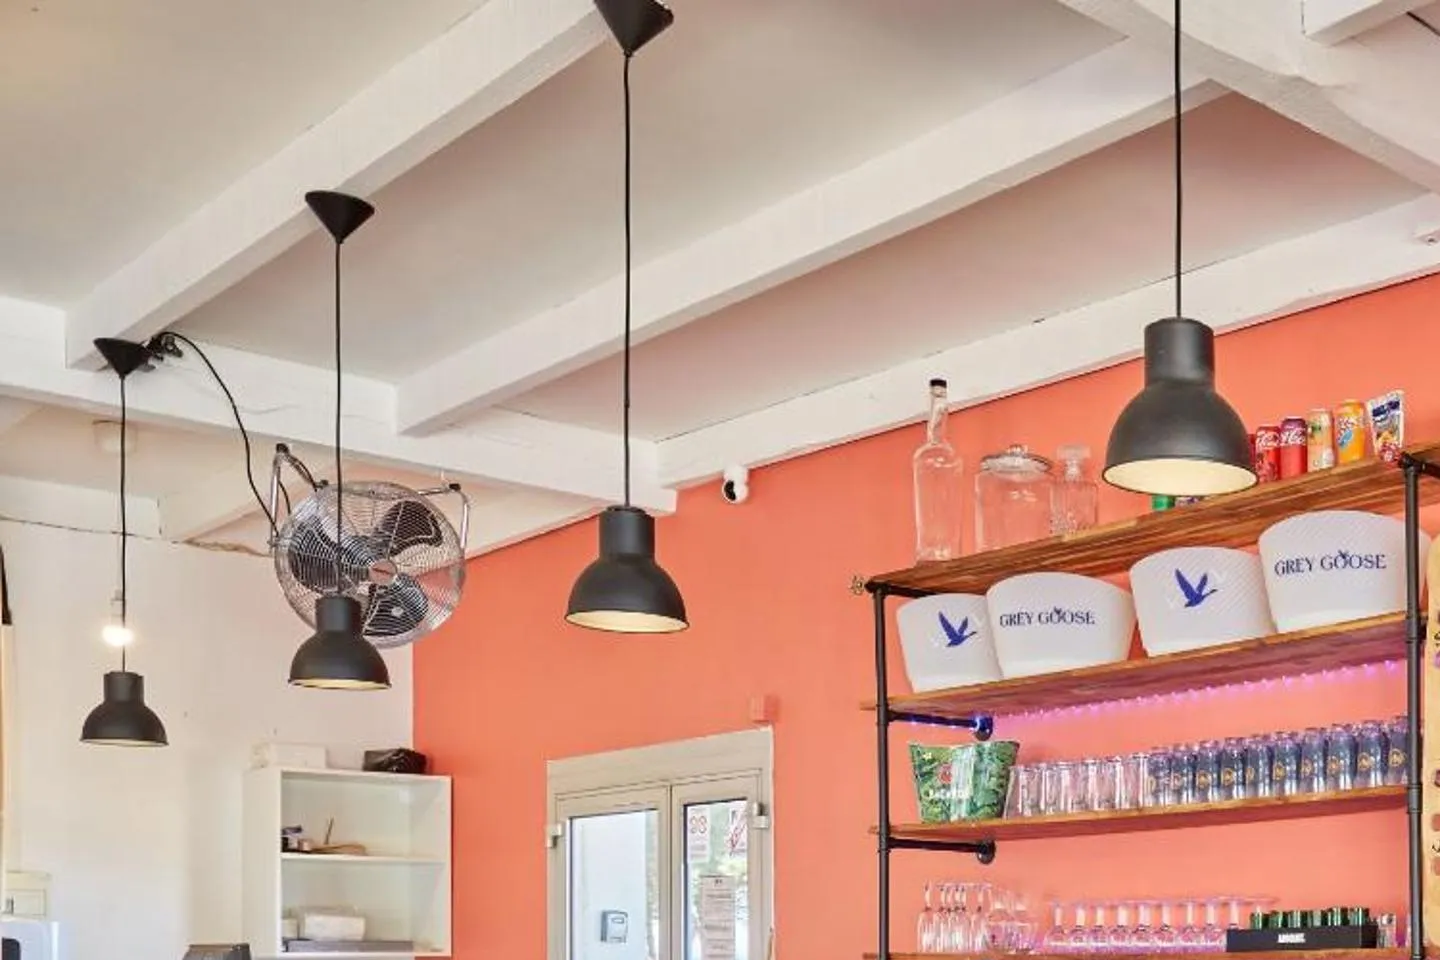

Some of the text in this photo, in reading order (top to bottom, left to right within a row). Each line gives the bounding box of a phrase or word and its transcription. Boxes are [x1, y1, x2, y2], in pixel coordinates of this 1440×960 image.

[1274, 551, 1387, 576] GREY GOOSE
[1000, 608, 1095, 628] GREY GOOSE
